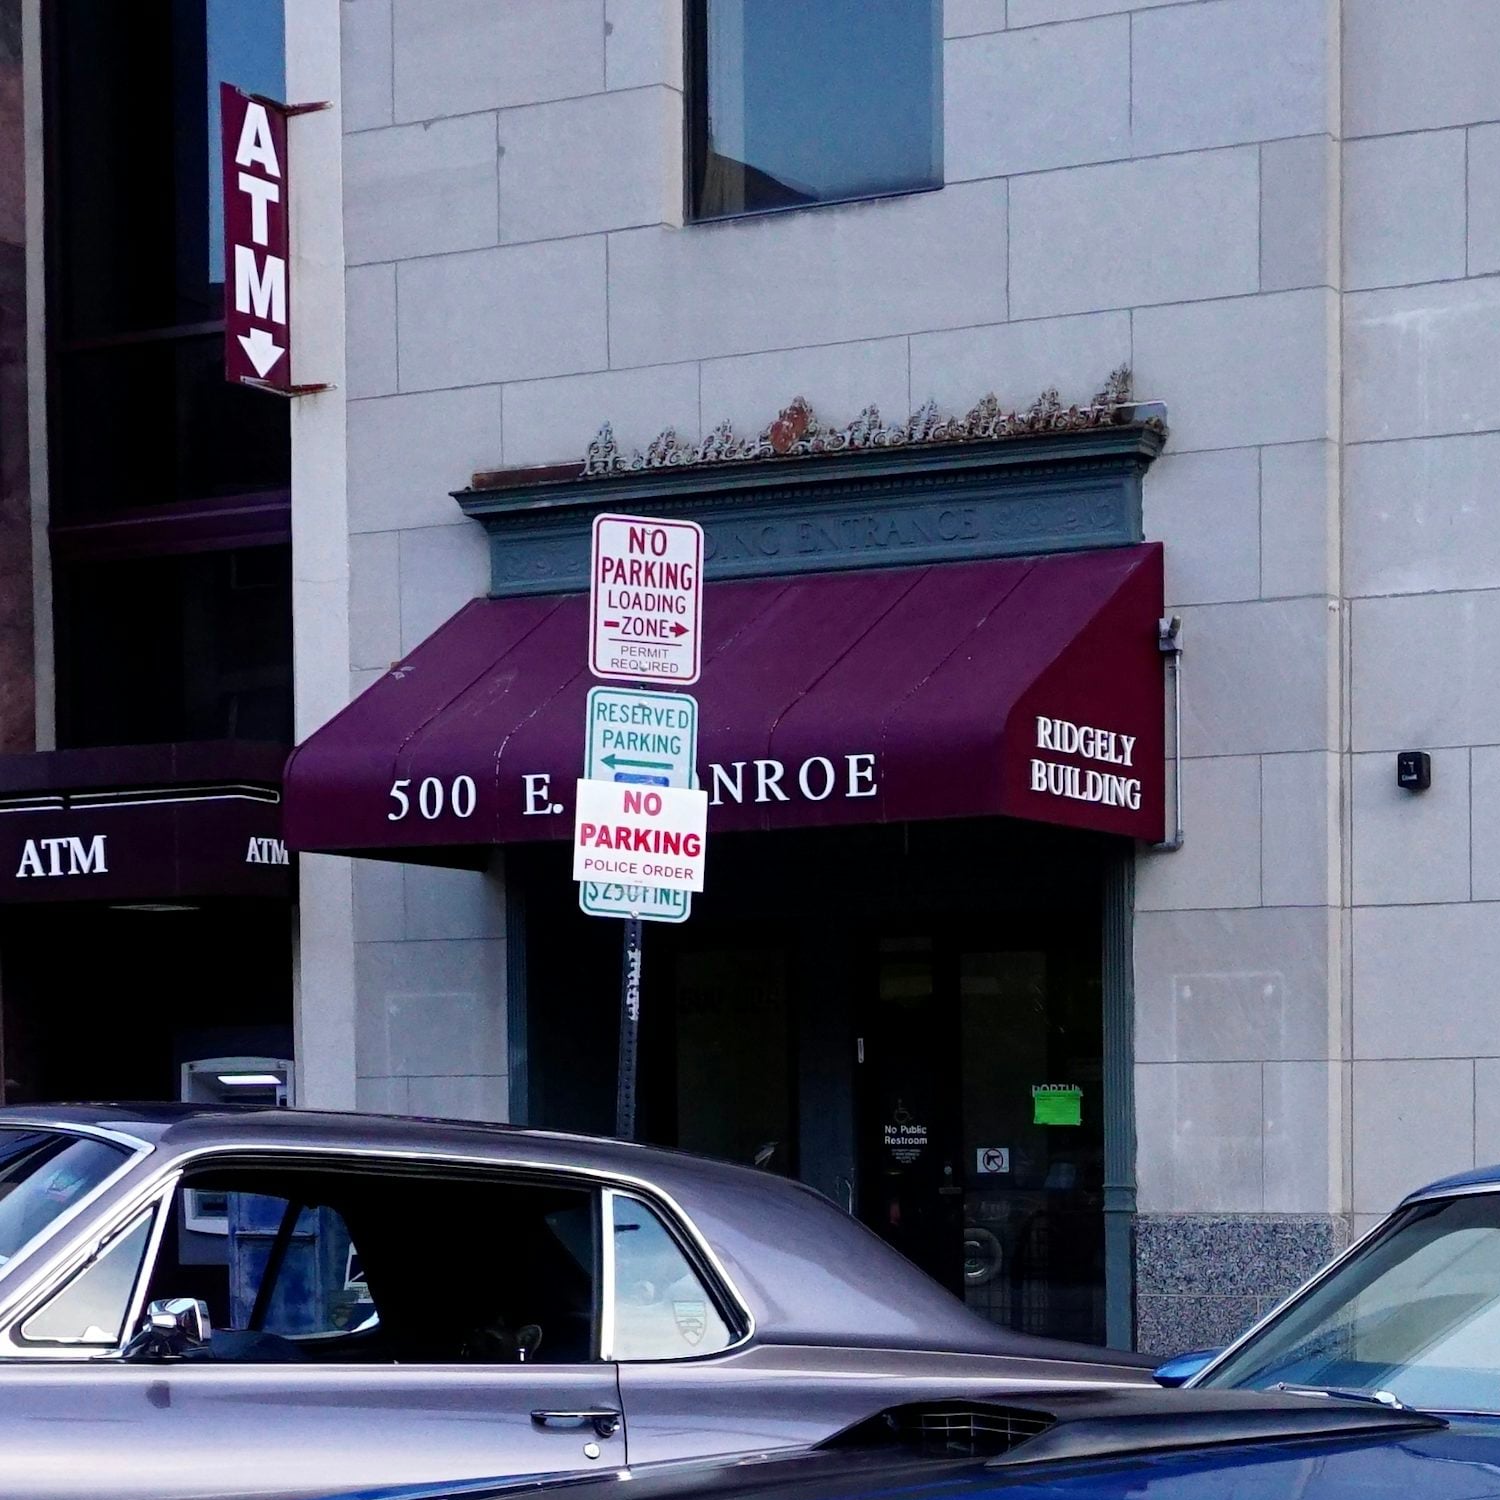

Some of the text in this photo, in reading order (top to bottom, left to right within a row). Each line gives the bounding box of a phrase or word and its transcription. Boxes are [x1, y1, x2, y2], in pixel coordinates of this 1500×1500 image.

[235, 101, 286, 325] ATM
[629, 526, 667, 557] NO
[601, 557, 693, 591] PARKING
[608, 590, 686, 614] LOADING
[621, 616, 670, 638] ZONE
[620, 645, 669, 658] PERMIT
[596, 702, 689, 729] RESERVED
[602, 729, 681, 755] PARKING
[1035, 716, 1136, 767] RIDGELY
[387, 753, 877, 821] 500 E. NROE
[1030, 759, 1142, 811] BUILDING
[623, 790, 662, 816] NO
[245, 836, 290, 865] ATM
[580, 823, 701, 858] PARKING
[16, 834, 109, 878] ATM
[584, 858, 694, 880] POLICE ORDER
[884, 1125, 927, 1135] No Public
[884, 1136, 928, 1145] Restroom
